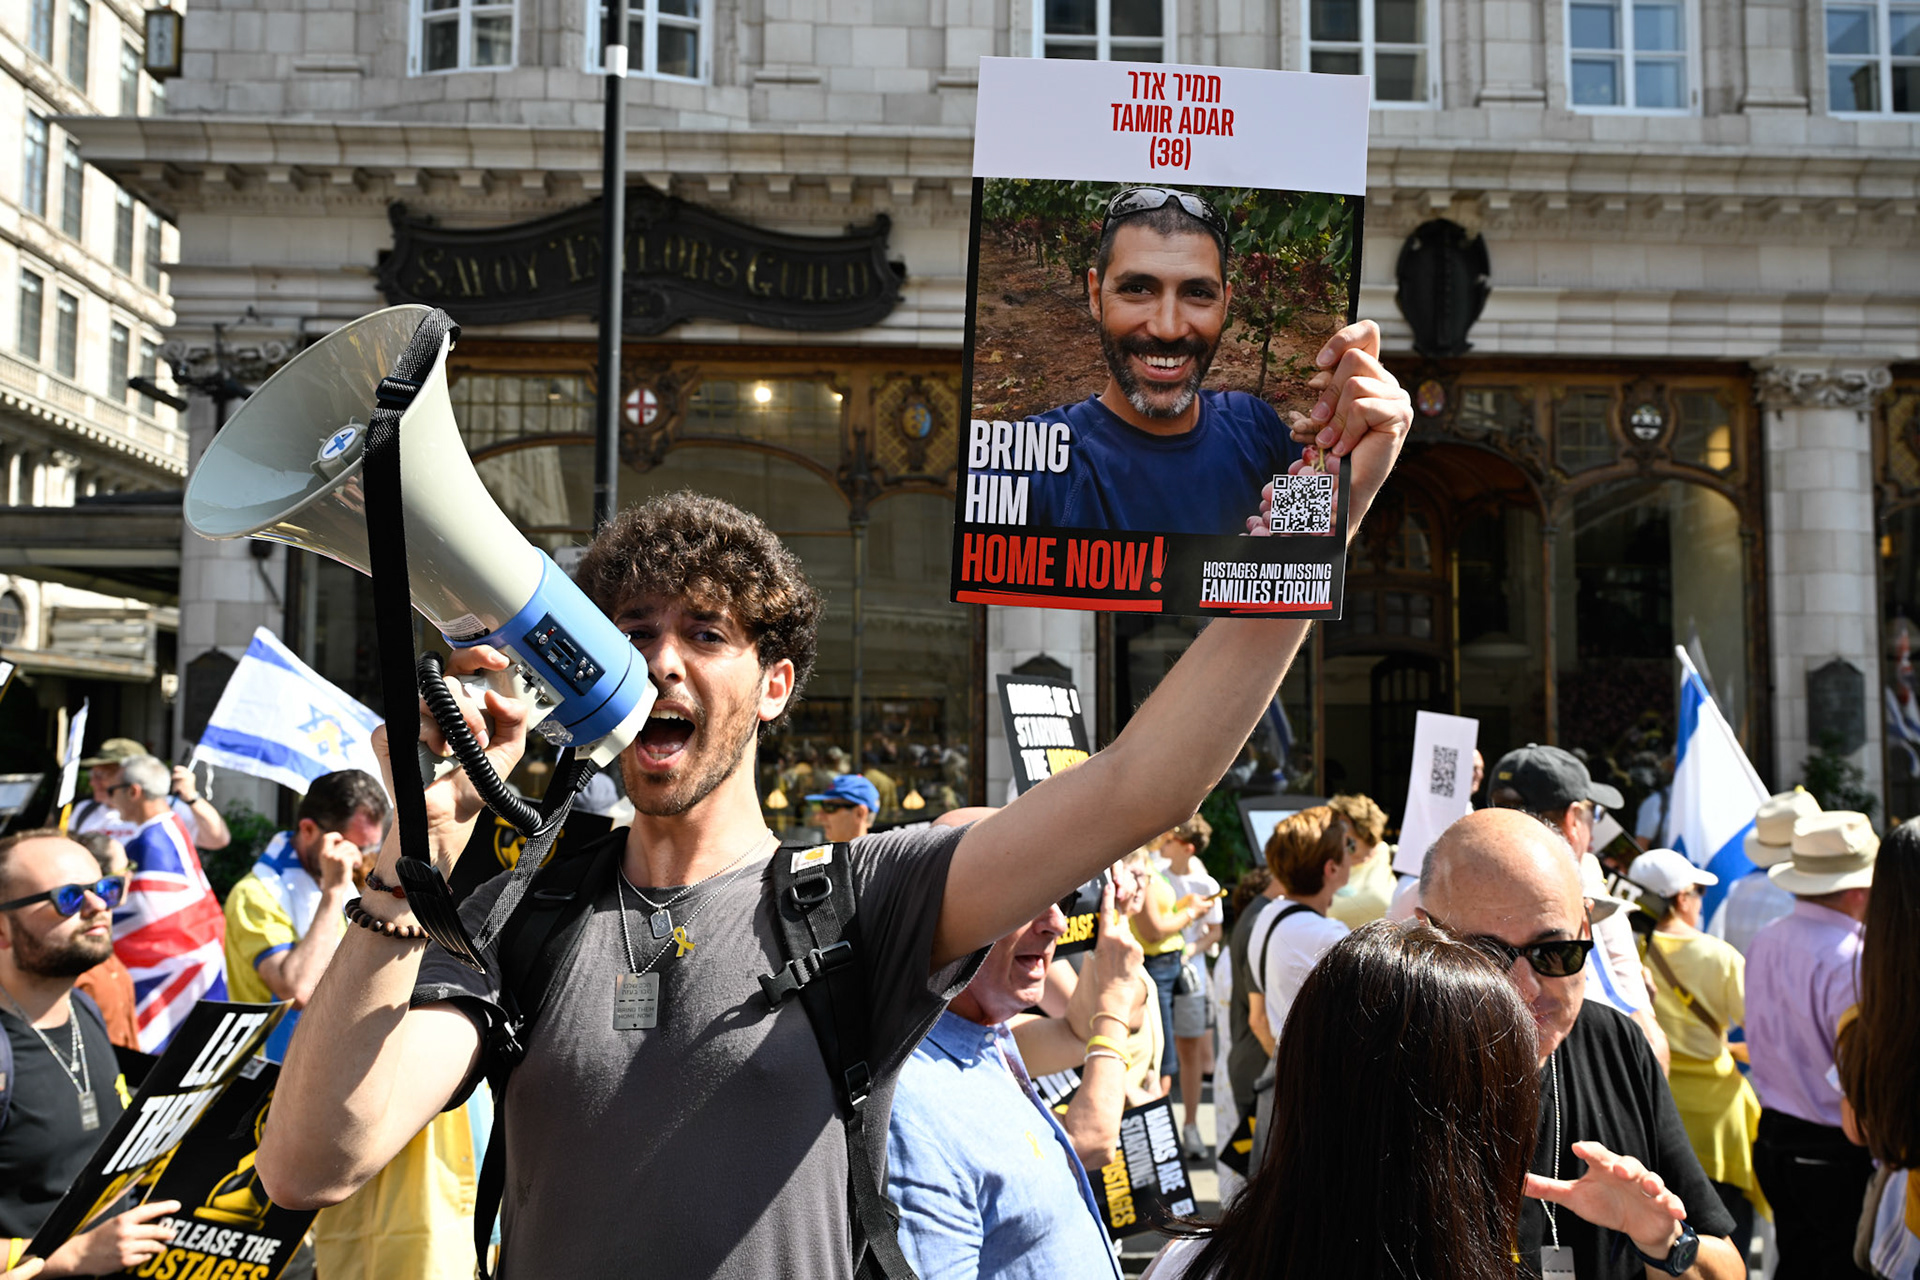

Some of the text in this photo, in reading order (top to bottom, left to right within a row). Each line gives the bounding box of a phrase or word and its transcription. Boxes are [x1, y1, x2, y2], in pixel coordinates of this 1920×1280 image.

[1127, 71, 1222, 103] תמיר אדר
[1111, 103, 1234, 137] TAMIR ADAR
[1149, 136, 1192, 170] (38)
[412, 247, 541, 297] SAVOY
[745, 250, 868, 300] GUILD
[968, 419, 1071, 473] BRING
[964, 474, 1030, 526] HIM
[961, 532, 1168, 593] HOME NOW!
[1202, 561, 1332, 580] HOSTAGES AND MISSING
[1201, 578, 1331, 604] FAMILIES FORUM
[1120, 1114, 1157, 1191] STARVING
[1144, 1104, 1187, 1196] HAMAS ARE
[238, 1236, 282, 1265] THE
